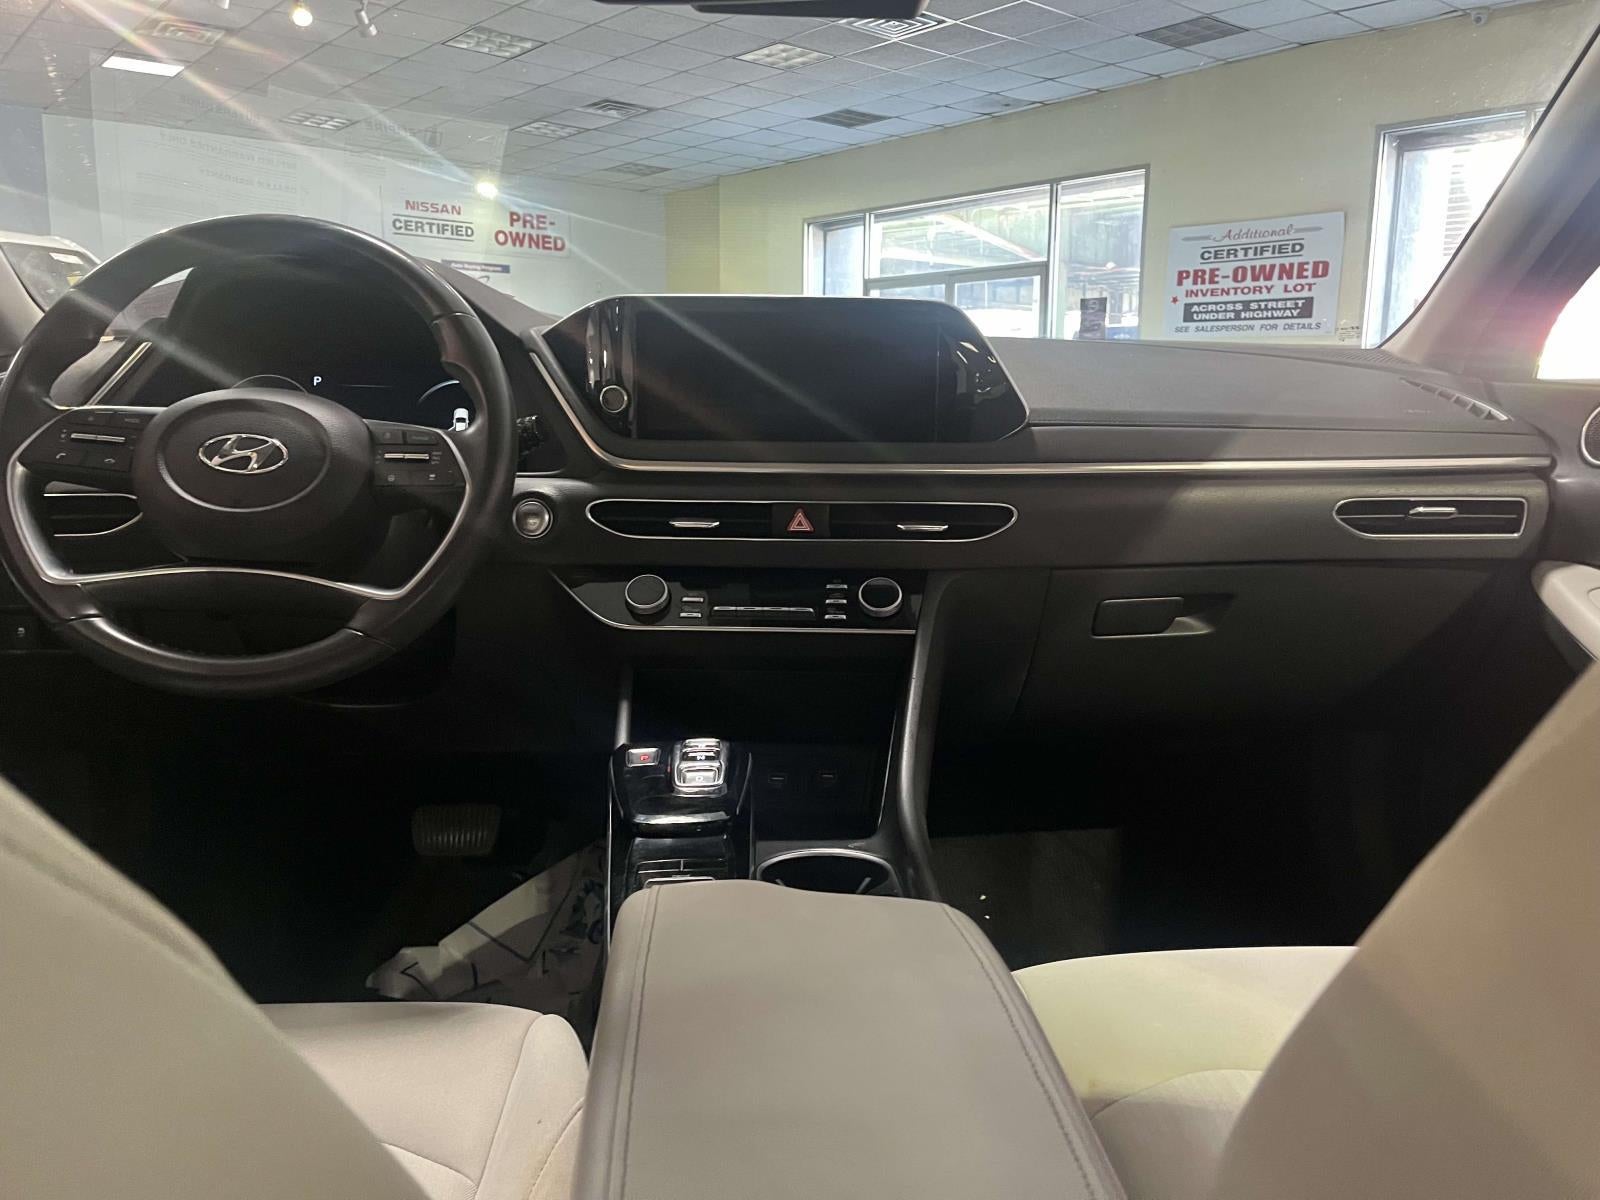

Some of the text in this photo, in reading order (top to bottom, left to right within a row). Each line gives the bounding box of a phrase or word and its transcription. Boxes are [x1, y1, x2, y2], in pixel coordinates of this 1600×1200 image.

[405, 199, 462, 215] NISSAN
[392, 218, 474, 238] CERTIFIED
[509, 211, 556, 230] PRE-
[494, 230, 566, 251] OWNED
[1212, 223, 1295, 242] Additional
[1200, 242, 1305, 261] CERTIFIED
[1176, 260, 1330, 286] PRE-OWNED
[1185, 282, 1317, 298] INVENTORY LOT
[1191, 300, 1305, 313] ACROSS STREET
[1193, 309, 1300, 321] UNDER HIGHWAY
[1194, 324, 1255, 333] SALESPERSON
[1260, 323, 1278, 331] FOR
[1283, 322, 1322, 331] DETAILS
[313, 376, 322, 387] P
